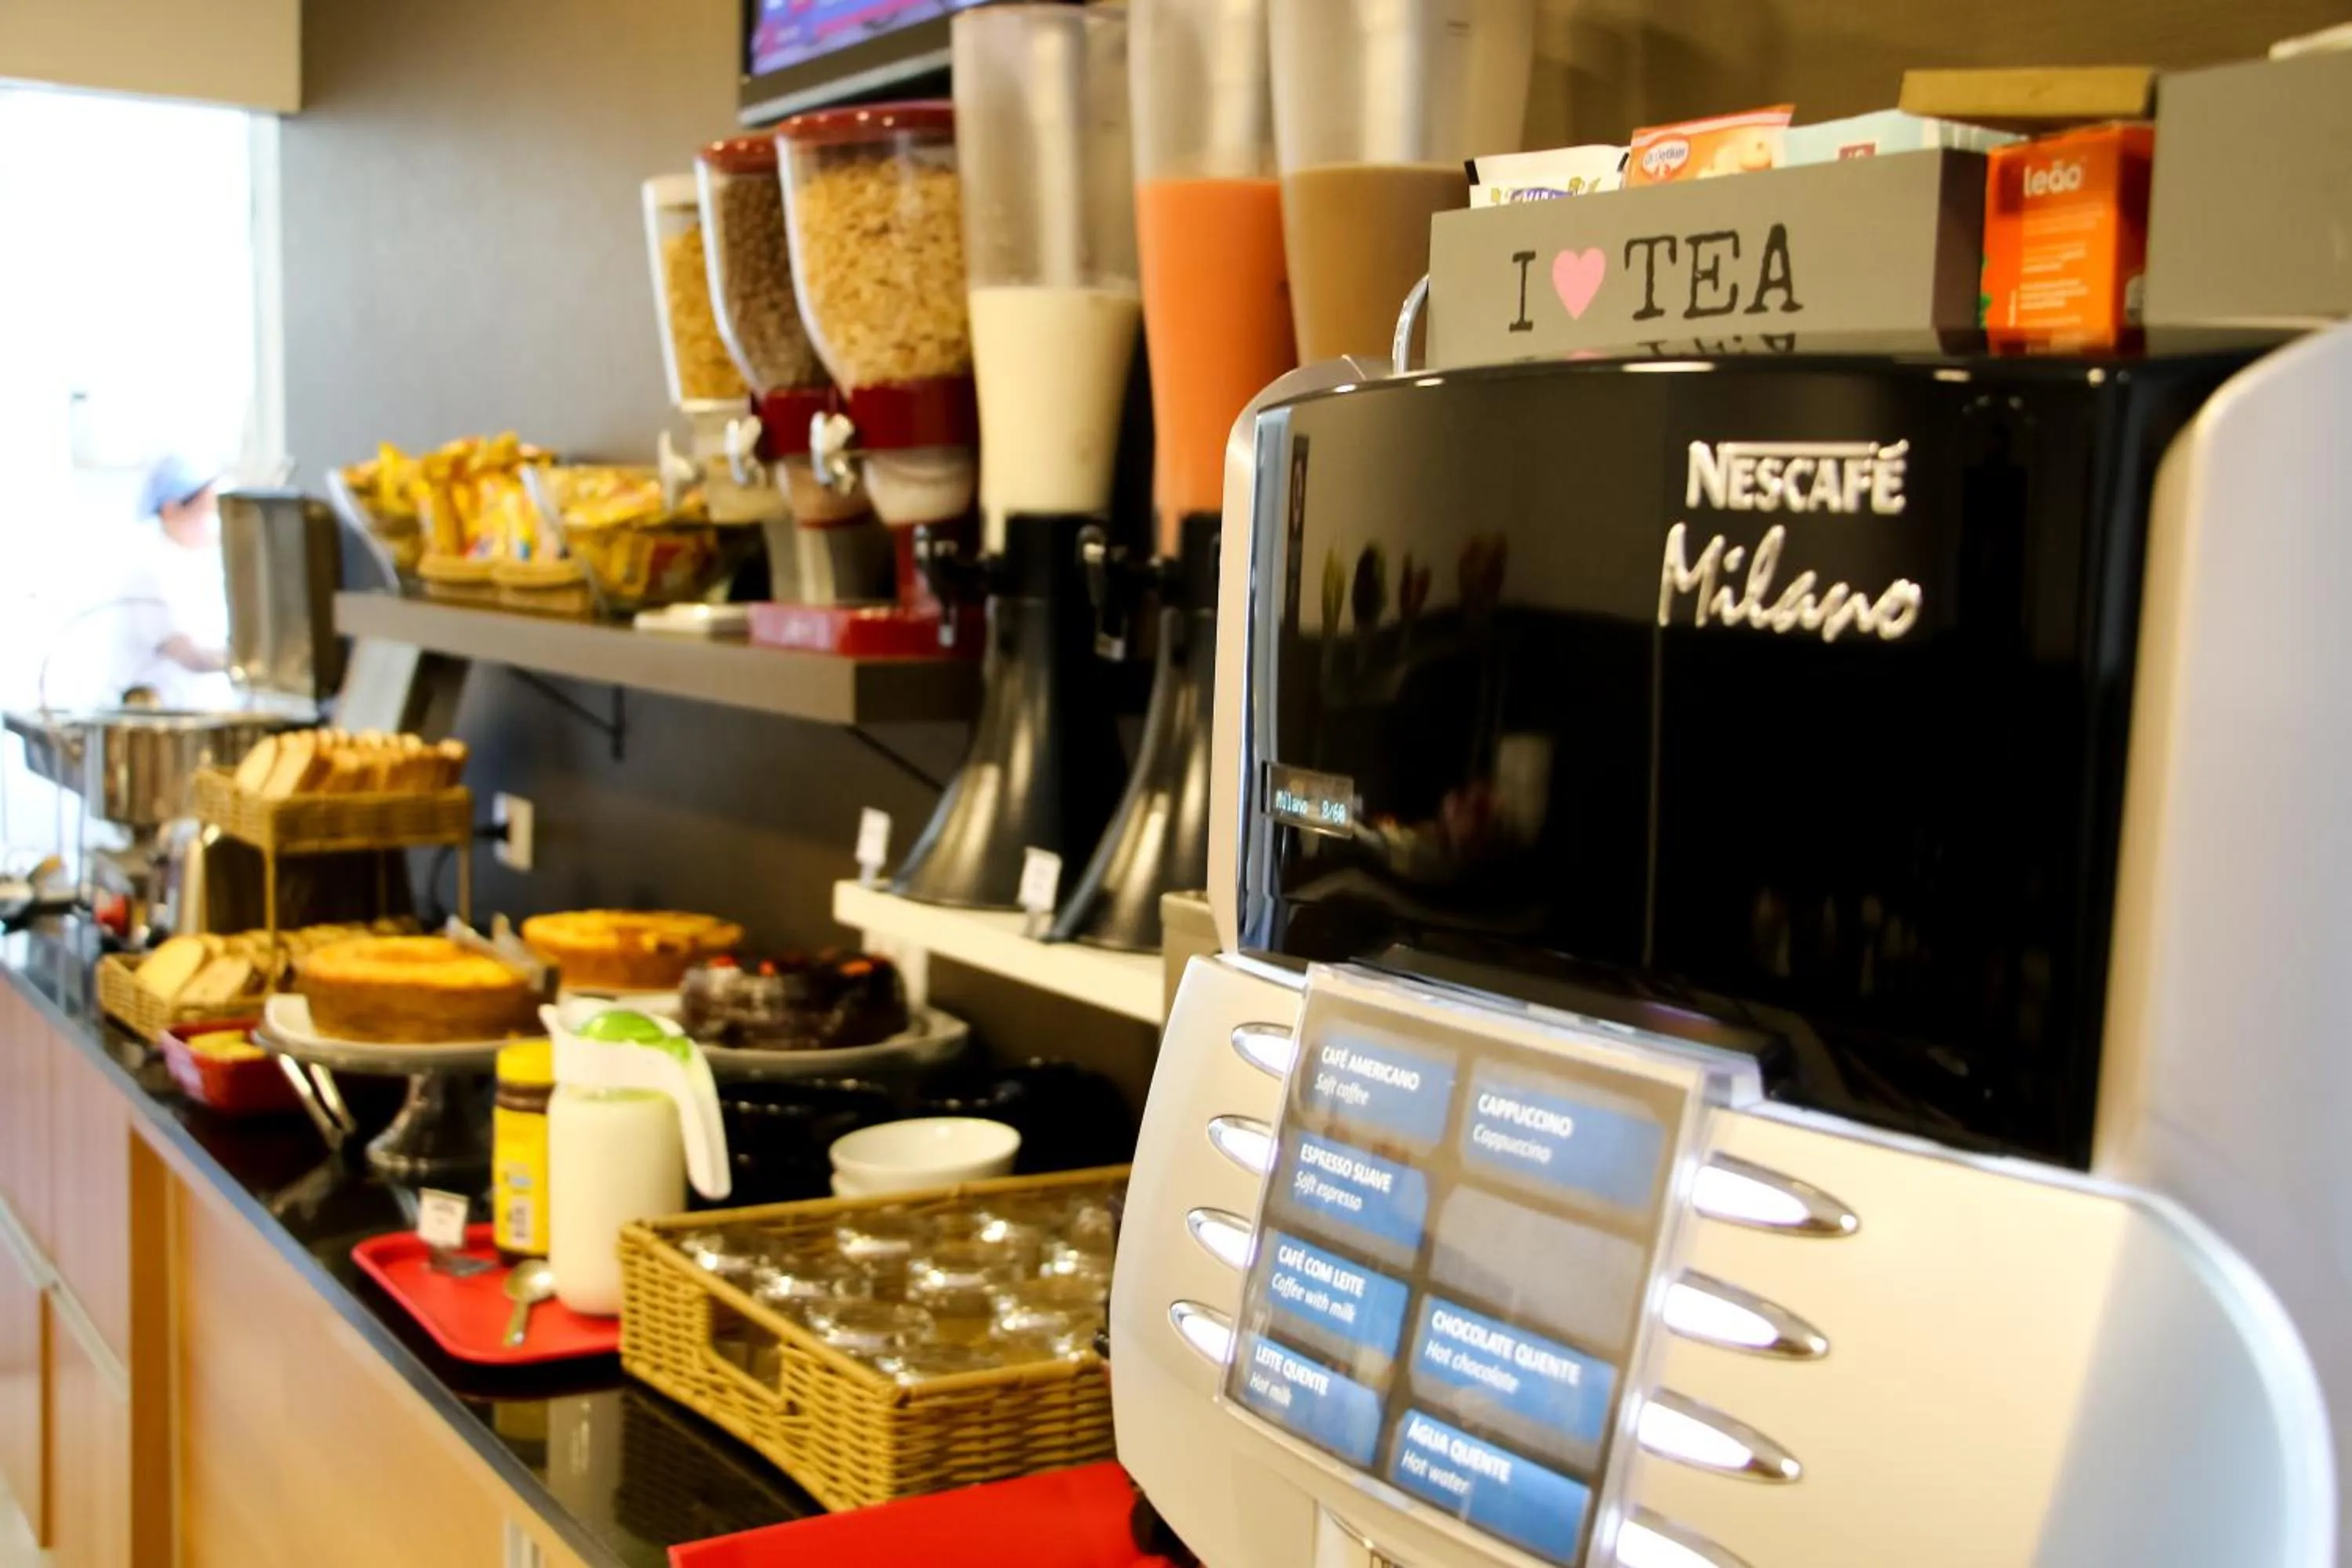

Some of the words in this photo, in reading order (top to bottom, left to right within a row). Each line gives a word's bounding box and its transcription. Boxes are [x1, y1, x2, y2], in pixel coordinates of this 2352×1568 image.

[2024, 160, 2082, 197] leão
[1509, 250, 1537, 332] I
[1624, 223, 1804, 321] TEA
[1657, 522, 1922, 643] Milano
[1315, 1073, 1338, 1096] Soft
[1336, 1082, 1370, 1105] coffee
[1321, 1046, 1349, 1069] CAFÉ
[1348, 1054, 1420, 1091] AMERICANO
[1479, 1093, 1573, 1138] CAPPUCCINO
[1473, 1123, 1552, 1164] Cappuccino
[1300, 1143, 1353, 1178] ESPRESSO
[1352, 1163, 1392, 1193] SUAVE
[1294, 1171, 1317, 1194] Soft
[1316, 1183, 1363, 1211] espresso
[1278, 1245, 1305, 1272] CAFÉ
[1305, 1257, 1334, 1283] COM
[1332, 1269, 1366, 1298] LEITE
[1272, 1272, 1305, 1301] Coffee
[1305, 1290, 1330, 1312] with
[1329, 1302, 1356, 1325] milk
[1255, 1344, 1284, 1374] LEITE
[1283, 1359, 1330, 1396] QUENTE
[1425, 1339, 1453, 1366] Hot
[1452, 1352, 1520, 1395] chocolate
[1432, 1309, 1516, 1360] CHOCOLATE
[1515, 1343, 1581, 1386] QUENTE
[1250, 1371, 1270, 1394] Hot
[1401, 1450, 1428, 1476] Hot
[1428, 1465, 1471, 1495] water
[1450, 1439, 1512, 1484] QUENTE
